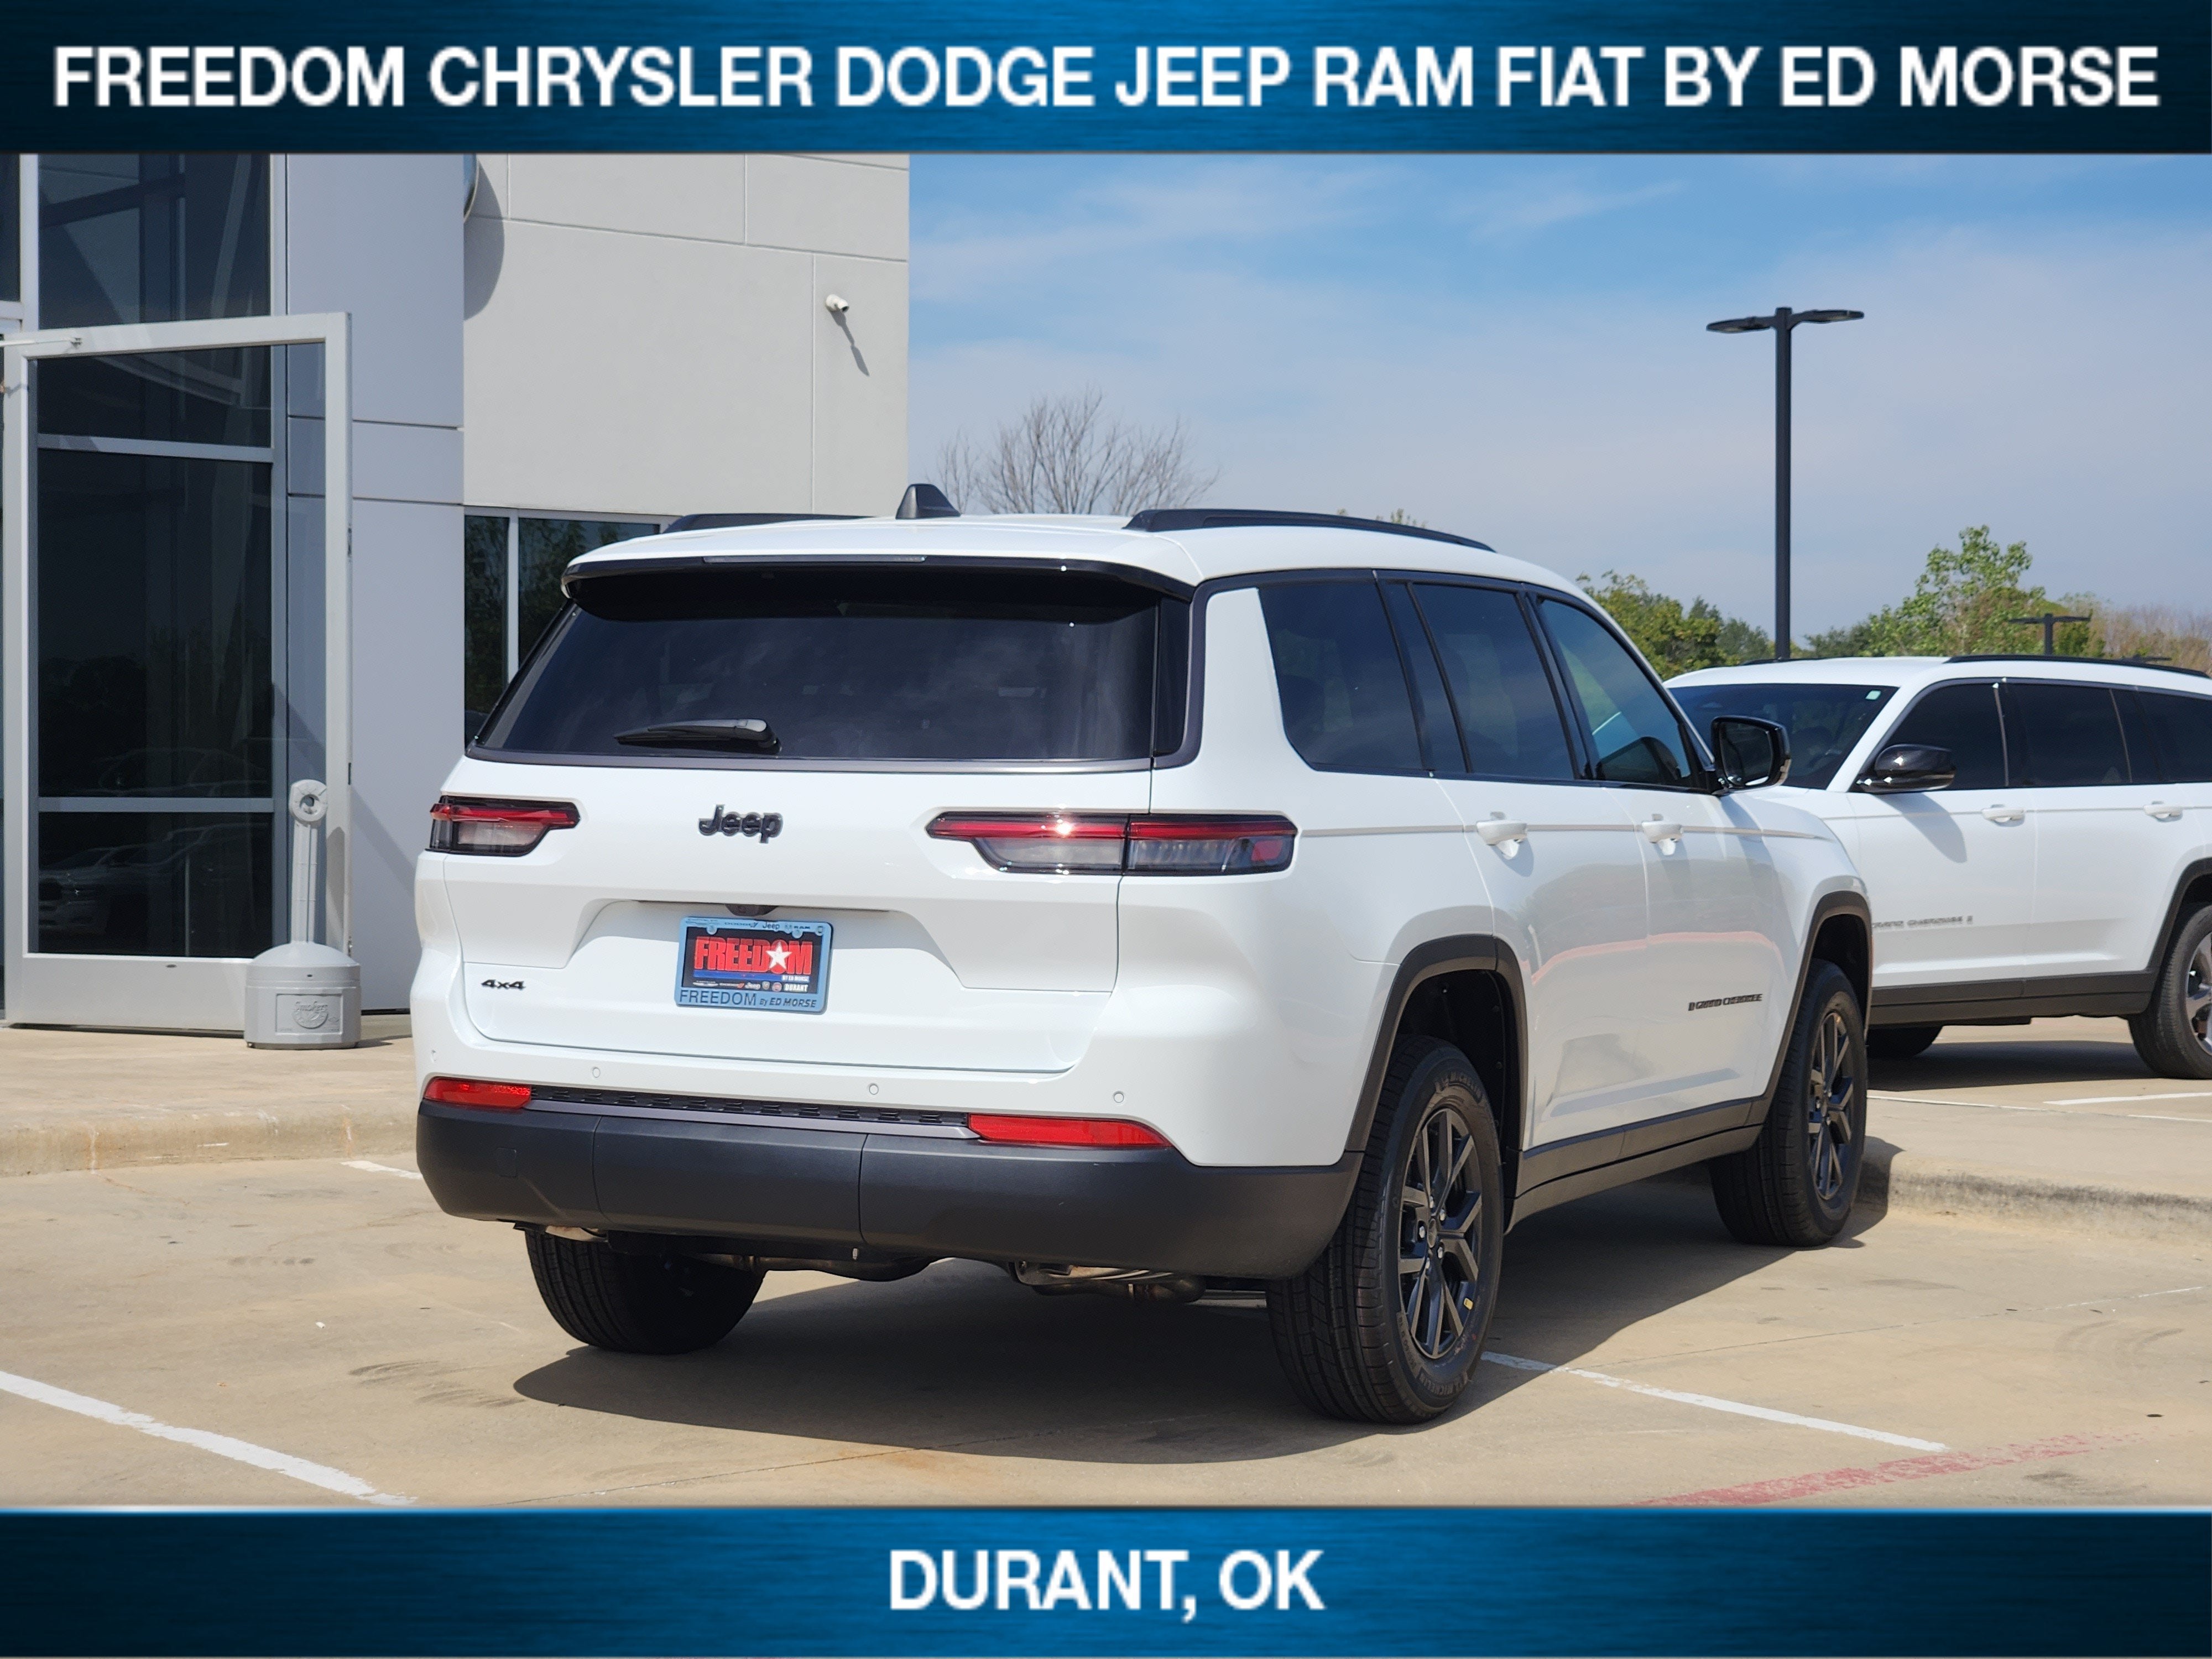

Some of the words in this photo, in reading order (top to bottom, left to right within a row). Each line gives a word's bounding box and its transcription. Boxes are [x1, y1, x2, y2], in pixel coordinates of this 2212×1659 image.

[698, 804, 783, 844] Jeep
[694, 936, 813, 975] FREEDOM
[481, 979, 526, 990] 4x4
[679, 989, 757, 1006] FREEDOM
[769, 997, 782, 1006] ED
[784, 998, 817, 1008] MORSE
